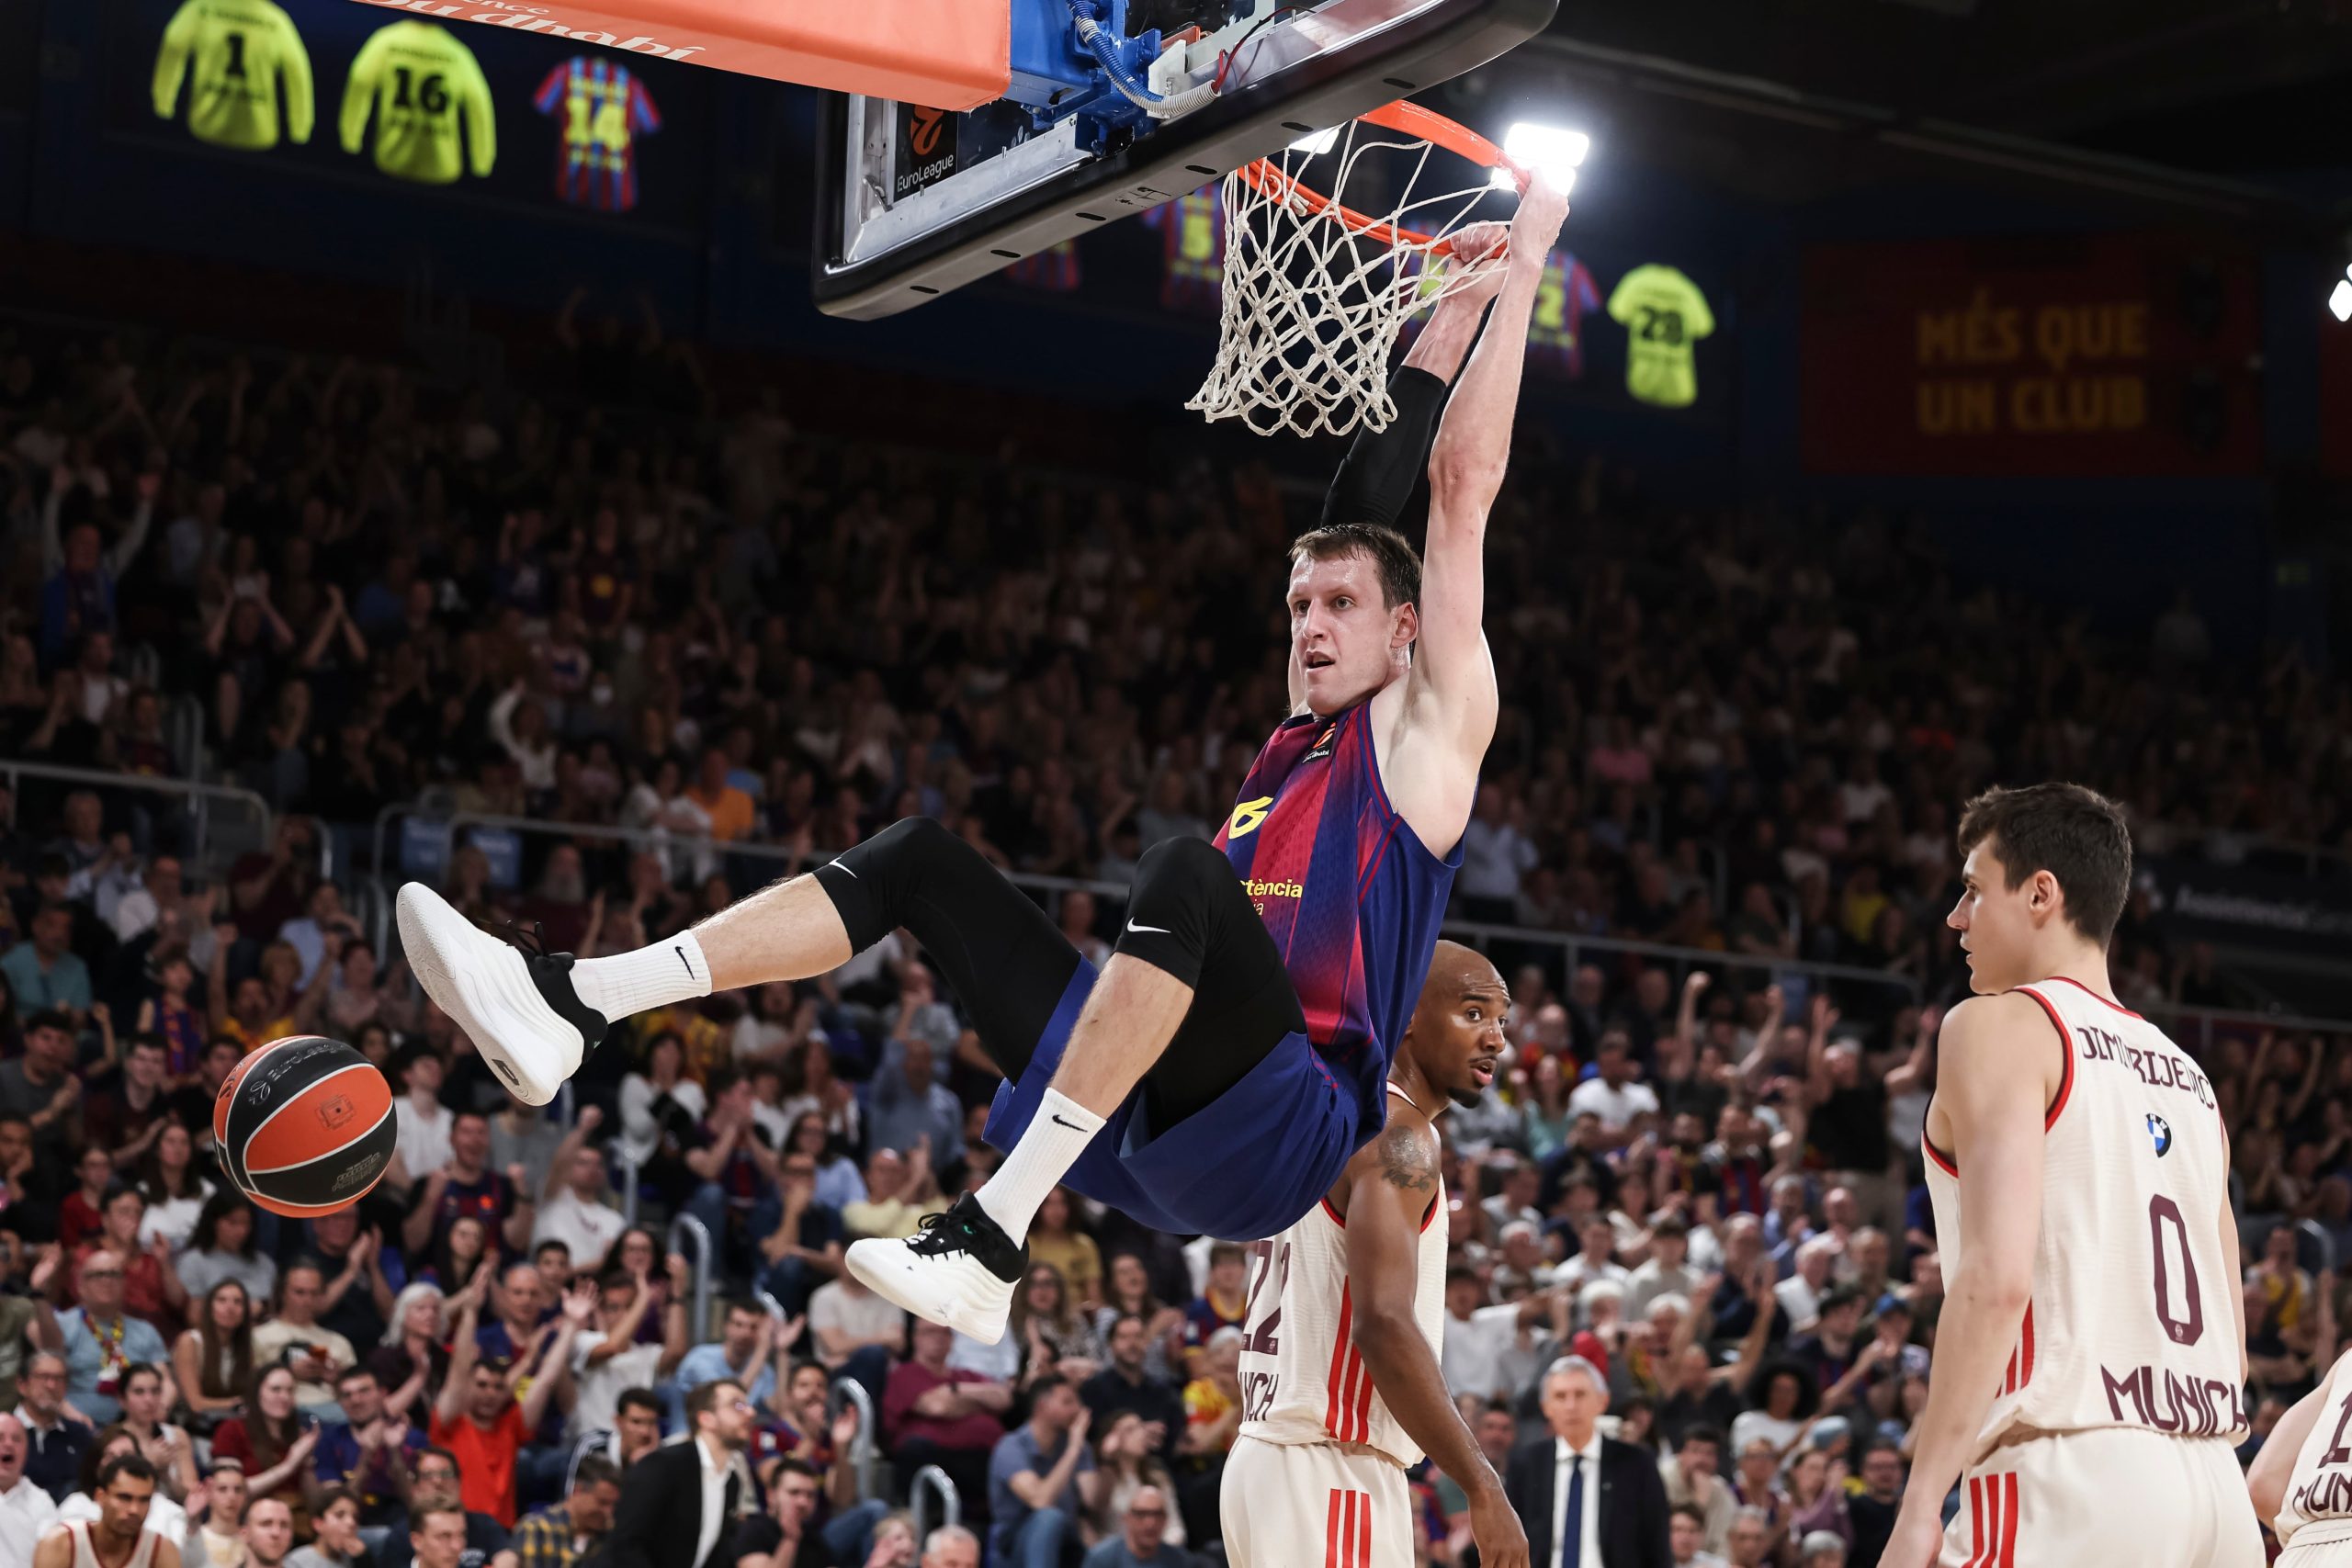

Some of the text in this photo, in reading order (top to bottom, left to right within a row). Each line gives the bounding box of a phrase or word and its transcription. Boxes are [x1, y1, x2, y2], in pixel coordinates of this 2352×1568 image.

[393, 66, 448, 114] 16
[897, 154, 954, 193] EuroLeague
[1917, 283, 2149, 370] MÉS QUE
[1917, 374, 2145, 436] UN CLUB
[1228, 795, 1273, 840] 6
[2149, 1193, 2204, 1347] 0
